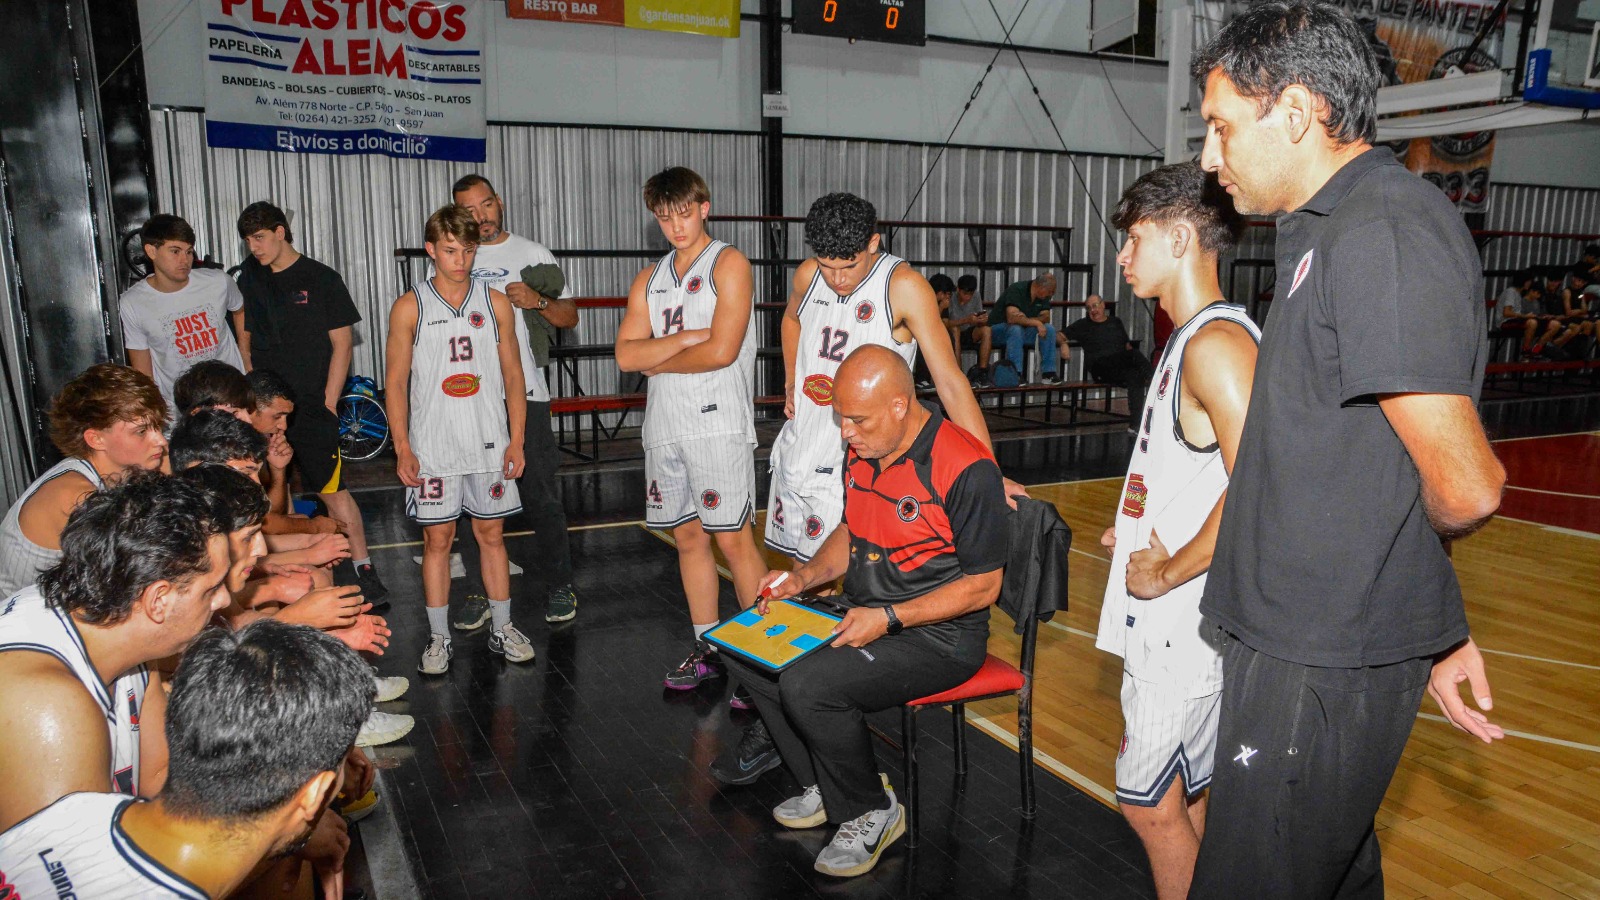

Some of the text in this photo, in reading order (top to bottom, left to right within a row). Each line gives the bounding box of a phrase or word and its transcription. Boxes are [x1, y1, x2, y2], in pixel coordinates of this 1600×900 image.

[523, 0, 598, 15] RESTO BAR
[823, 0, 838, 22] 0
[885, 7, 899, 29] 0
[209, 37, 283, 60] PAPELERÍA
[291, 37, 408, 80] ALEM
[408, 59, 480, 73] DESCARTABLES
[222, 75, 276, 90] BANDEJAS
[285, 83, 327, 95] BOLSAS
[394, 89, 425, 102] VASOS
[434, 94, 472, 104] PLATOS
[255, 96, 271, 105] Av.
[299, 100, 318, 110] 778
[319, 102, 347, 111] Norte
[356, 102, 374, 111] C.P.
[404, 106, 422, 116] San
[422, 109, 444, 119] Juan
[278, 110, 293, 120] Tel:
[295, 112, 329, 125] (0264)
[331, 114, 376, 125] 421-3252
[276, 130, 426, 155] Envíos a domicilio
[175, 311, 210, 337] JUST
[662, 305, 684, 336] 14
[175, 327, 219, 355] START
[448, 336, 474, 362] 13
[818, 326, 849, 363] 12
[418, 477, 445, 501] 13
[646, 480, 662, 503] 4
